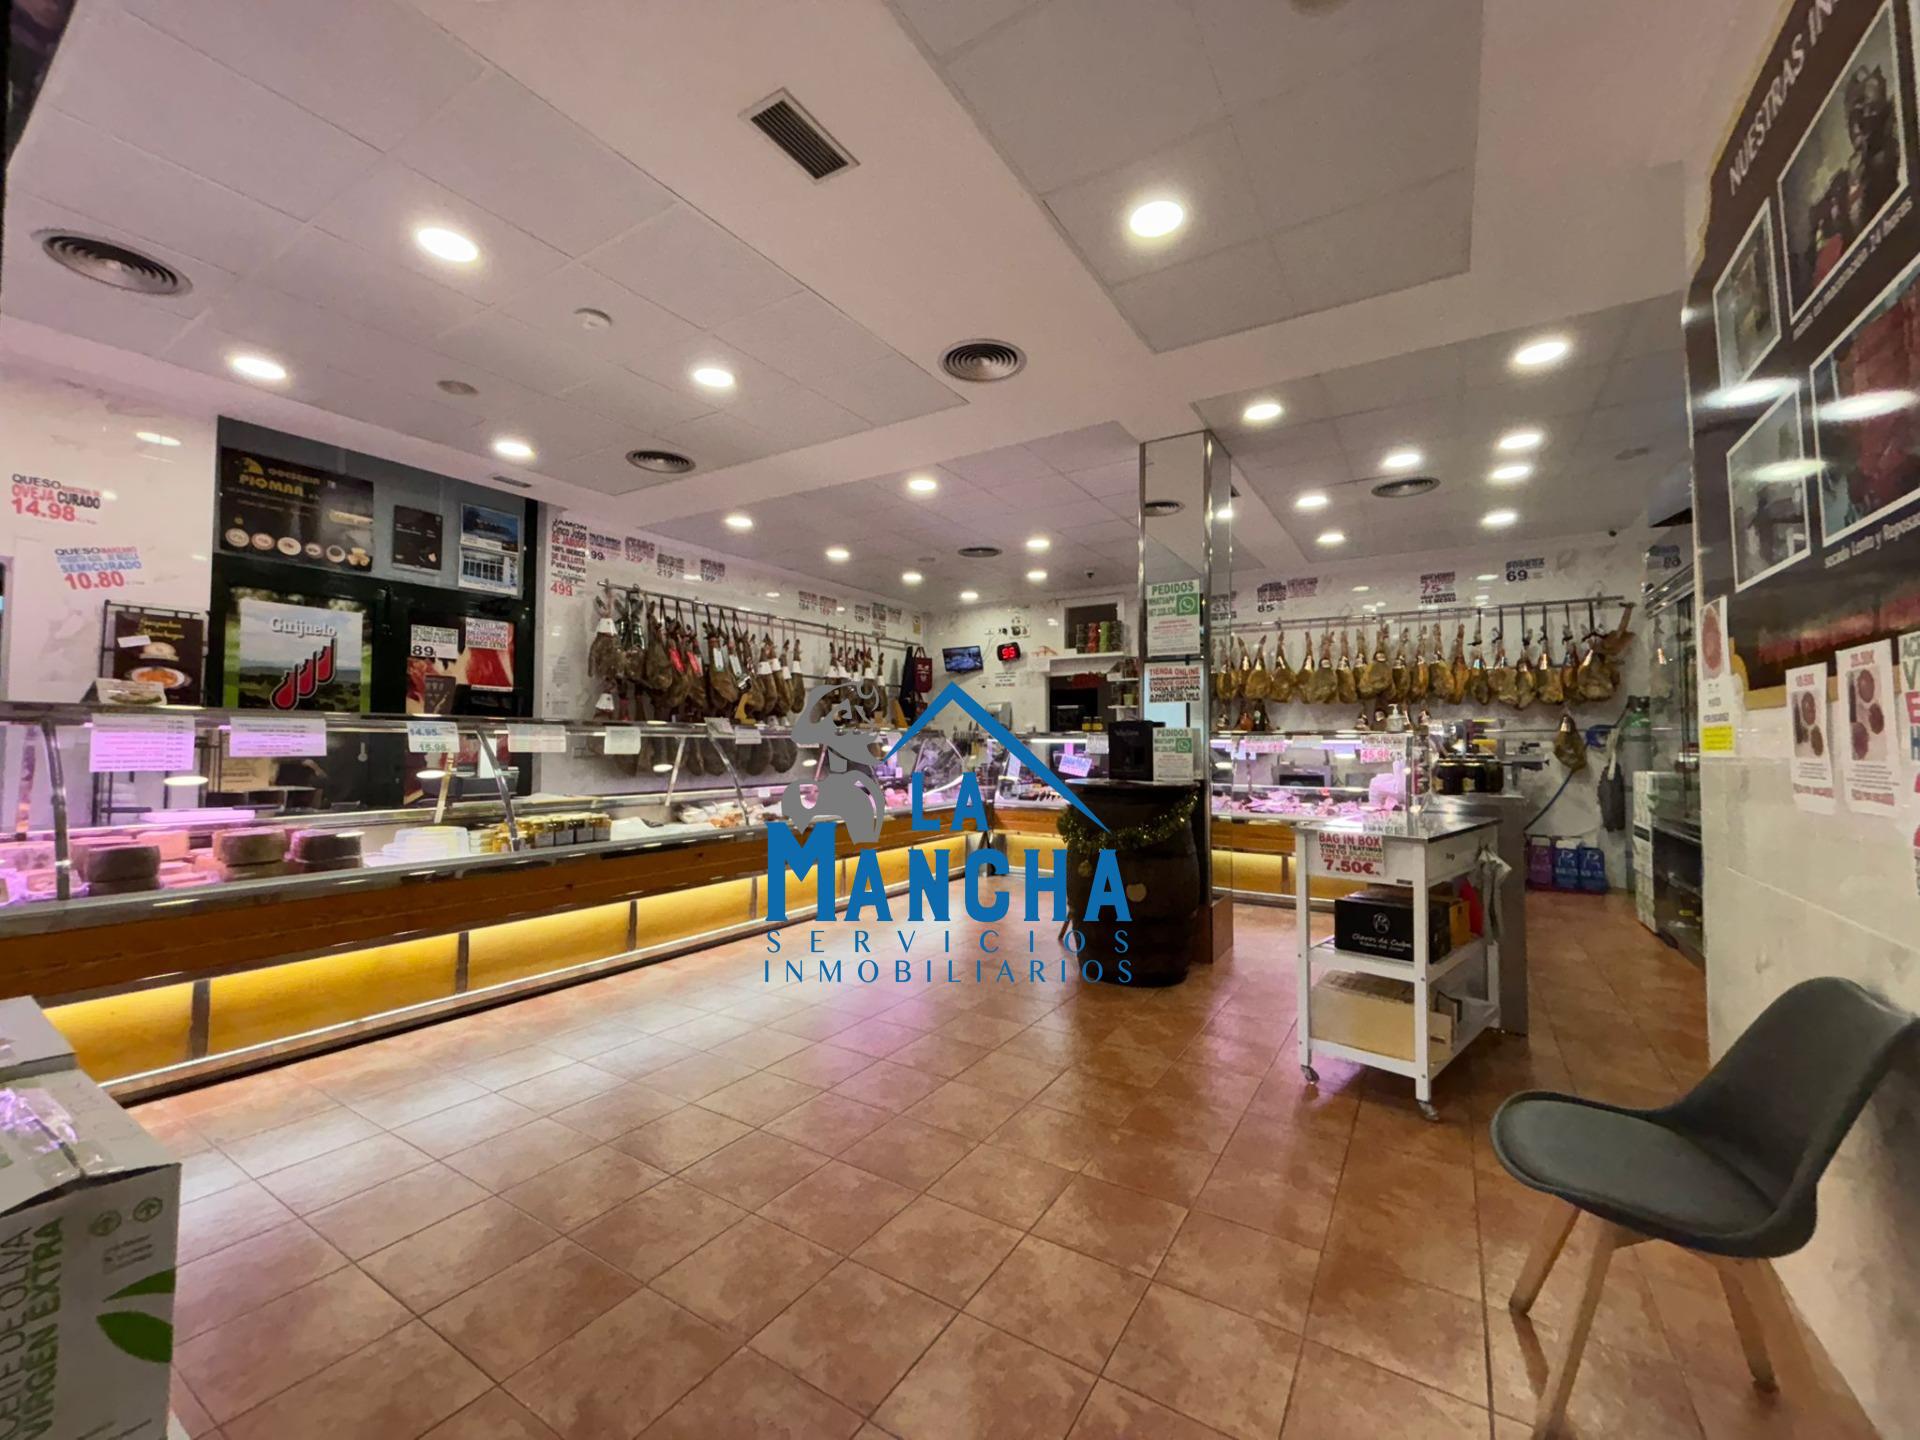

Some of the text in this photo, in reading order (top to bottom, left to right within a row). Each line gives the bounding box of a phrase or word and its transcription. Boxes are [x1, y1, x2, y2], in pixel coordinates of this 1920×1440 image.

[1727, 33, 1806, 196] NUESTRAS
[12, 473, 62, 489] QUESO
[12, 483, 101, 509] OVEJA CURADO
[11, 498, 76, 521] 14.98
[55, 547, 100, 556] QUESO
[60, 561, 142, 573] SEMICURADO
[64, 571, 125, 590] 10.80
[1506, 570, 1528, 582] 69
[550, 581, 573, 597] 499
[1152, 581, 1194, 596] PEDIDOS
[272, 618, 337, 639] Guijuelo
[412, 645, 434, 657] 89
[1157, 729, 1189, 737] PEDIDOS
[1319, 832, 1380, 848] BAG IN BOX
[0, 1226, 33, 1312] OLIVA
[22, 1216, 63, 1440] VIRGEN EXTRA
